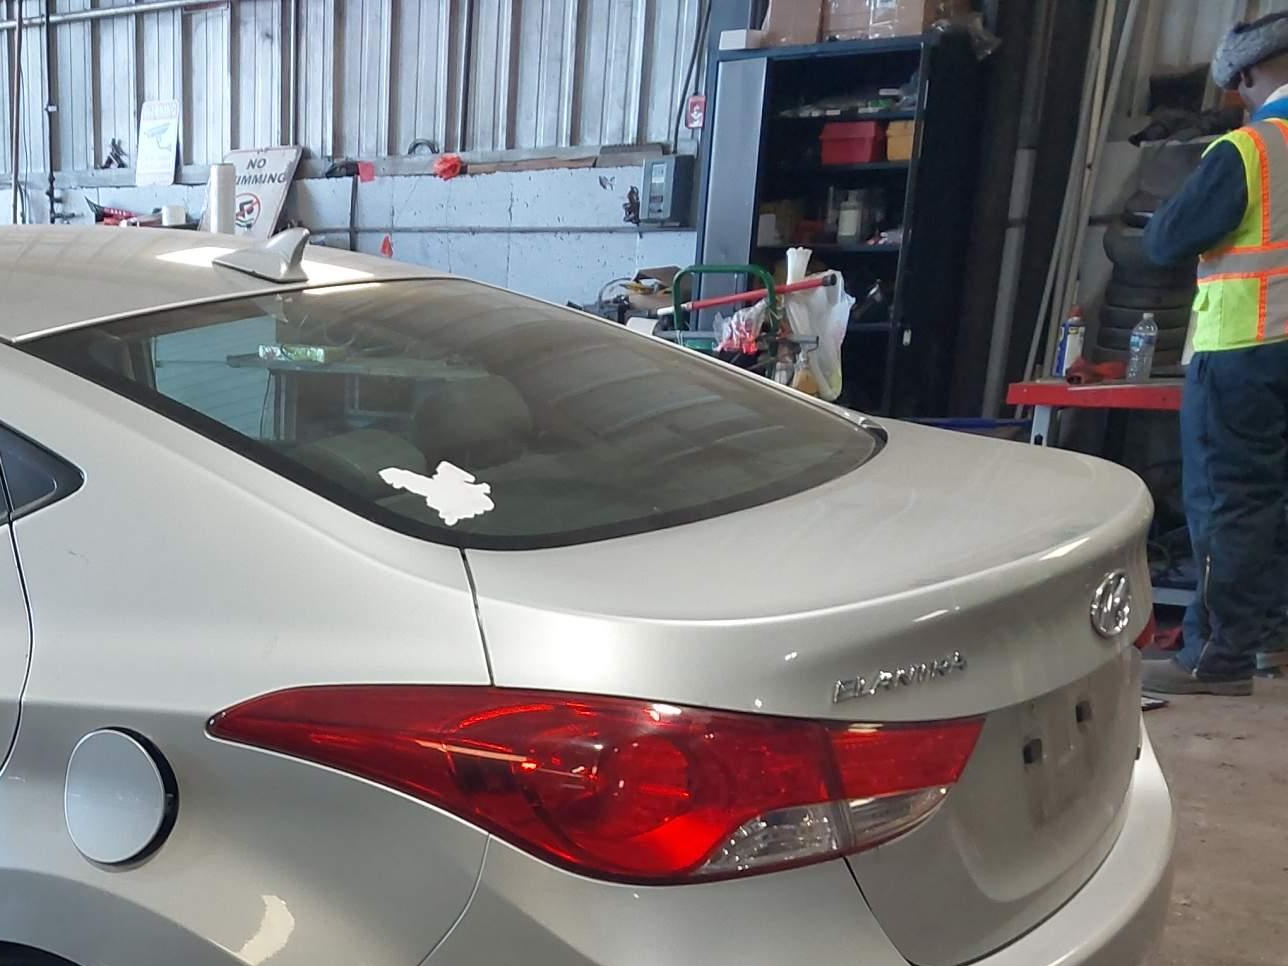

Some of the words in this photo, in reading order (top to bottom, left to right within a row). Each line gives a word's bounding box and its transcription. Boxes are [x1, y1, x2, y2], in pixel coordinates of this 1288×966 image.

[246, 158, 267, 170] NO
[236, 172, 286, 185] IMMING
[832, 651, 967, 703] ELANTRA
